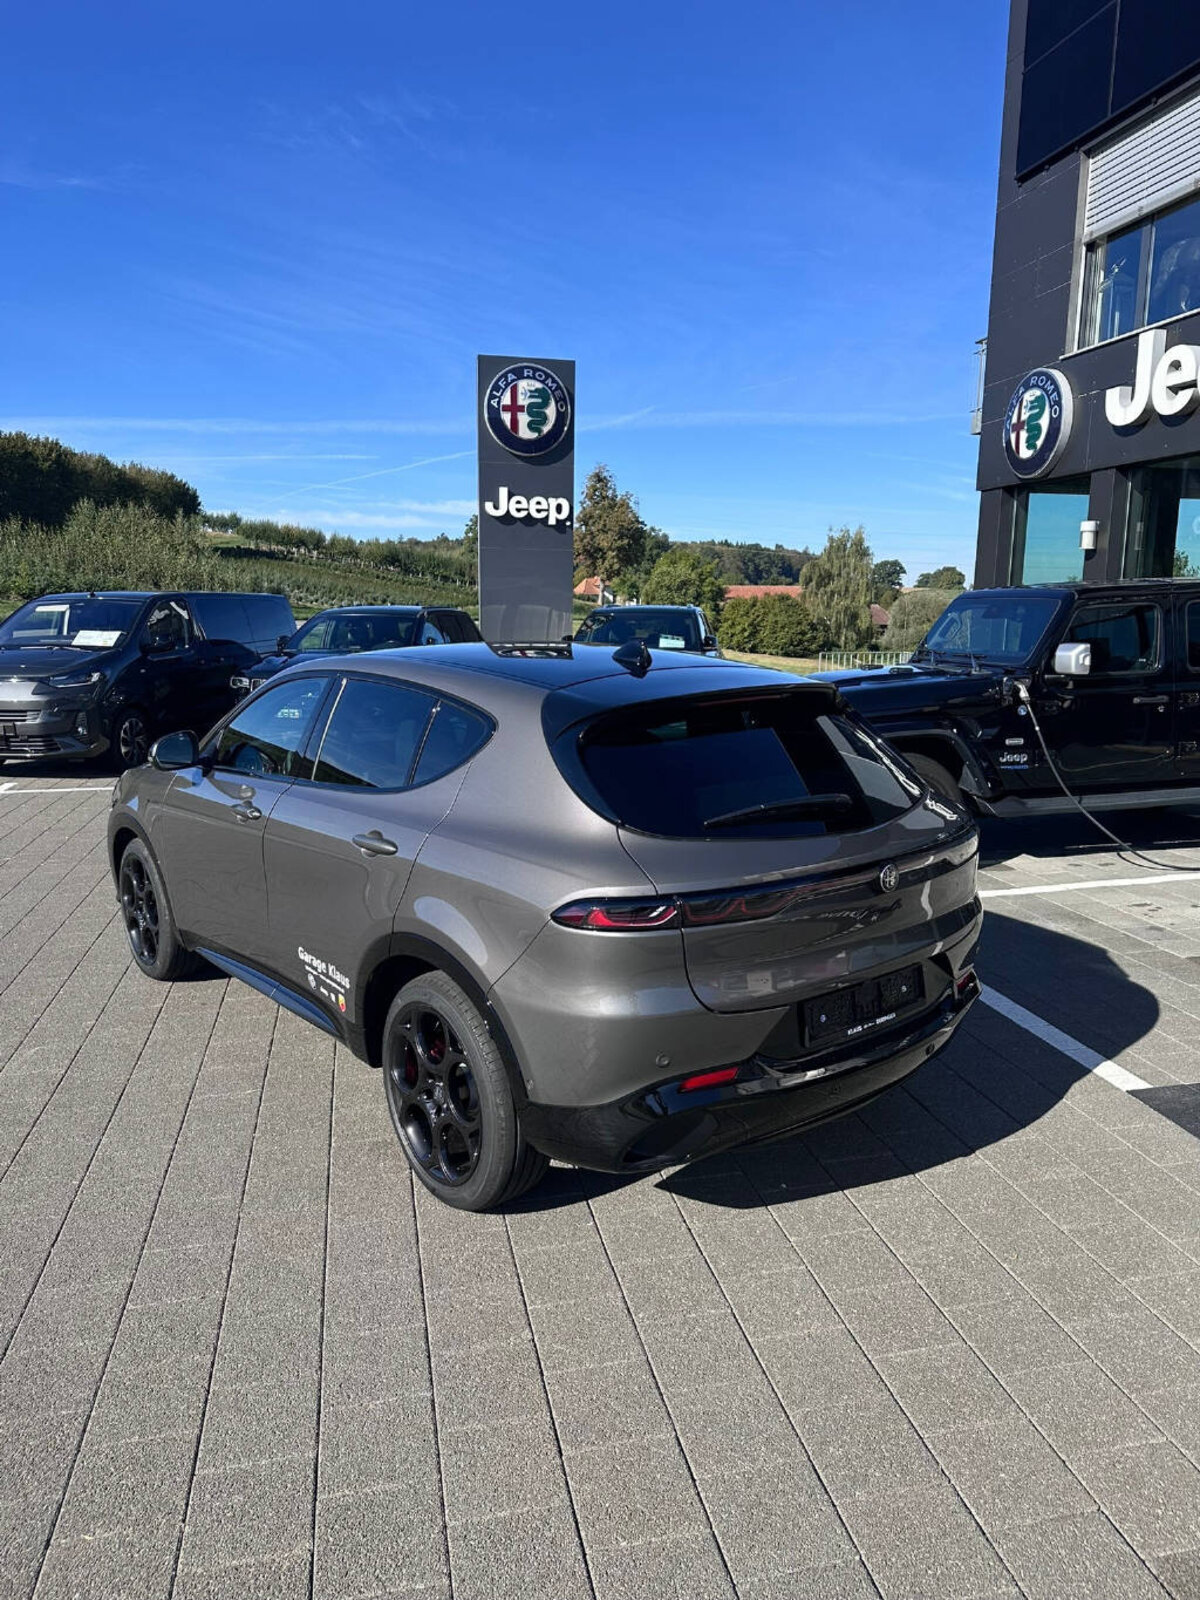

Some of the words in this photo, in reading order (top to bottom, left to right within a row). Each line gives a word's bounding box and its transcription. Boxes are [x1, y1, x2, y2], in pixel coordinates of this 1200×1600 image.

[490, 372, 517, 409] ALFA
[523, 368, 566, 413] ROMEO
[1030, 375, 1059, 418] ROMEO
[1104, 329, 1200, 426] Je
[999, 751, 1029, 764] Jeep
[298, 946, 327, 974] Garage
[328, 963, 351, 989] Klaus
